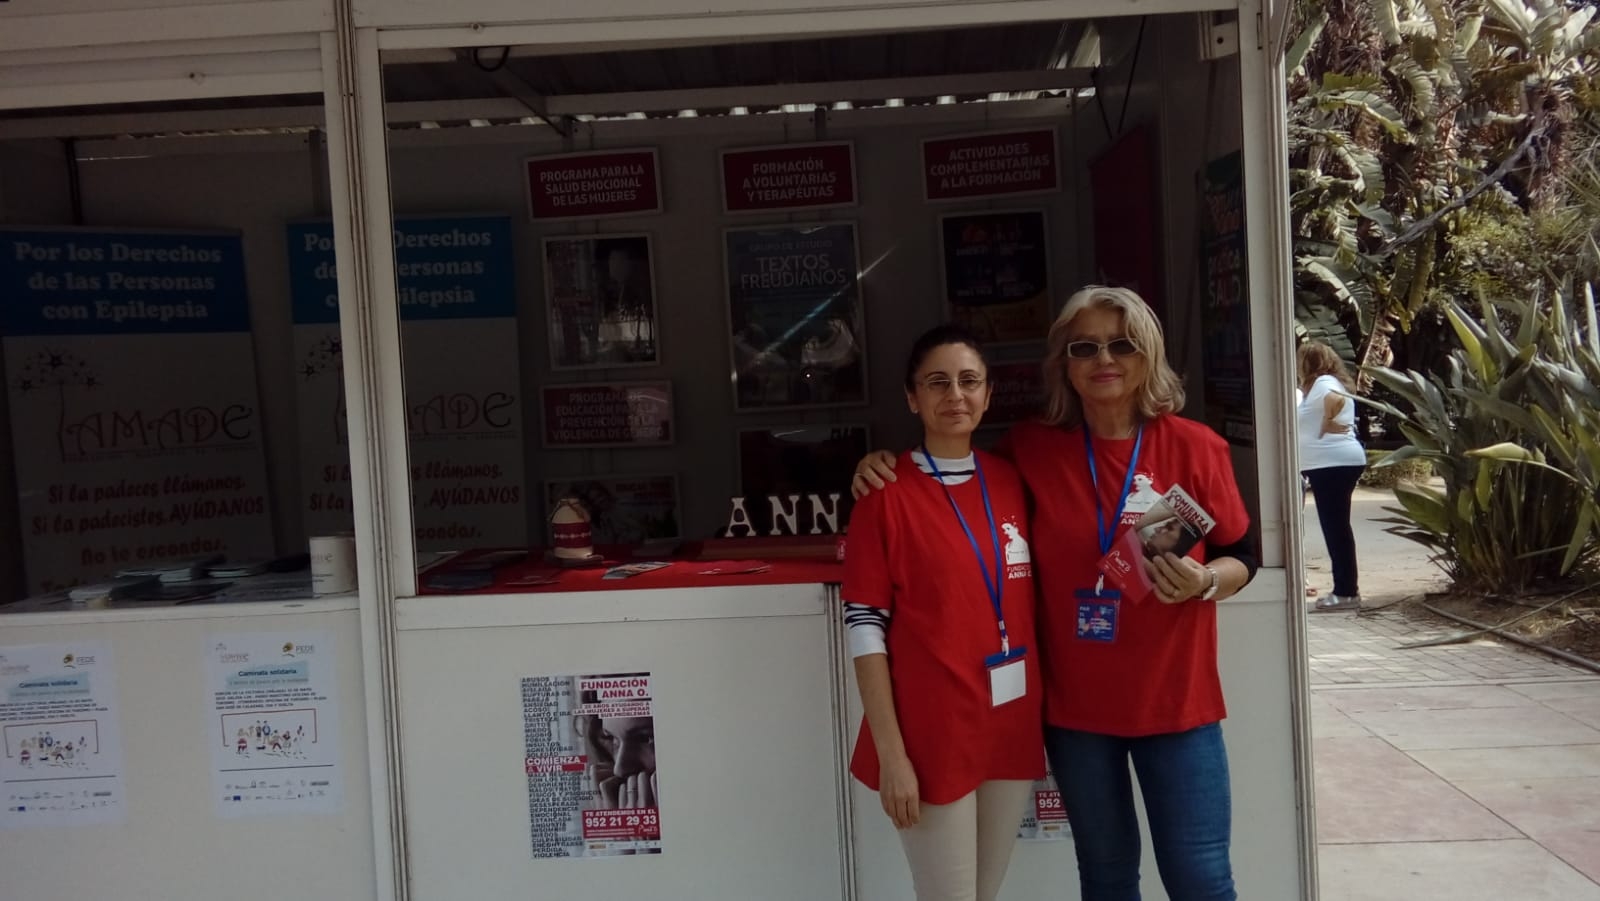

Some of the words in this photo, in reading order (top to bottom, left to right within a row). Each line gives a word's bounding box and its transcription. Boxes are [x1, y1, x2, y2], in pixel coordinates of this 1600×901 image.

[949, 142, 1030, 161] ACTIVIDADES
[540, 167, 600, 182] PROGRAMA
[601, 165, 630, 178] PARA
[630, 164, 645, 175] LA
[752, 156, 824, 175] FORMACIÓN
[930, 154, 1050, 176] COMPLEMENTARIAS
[545, 182, 580, 195] SALUD
[581, 177, 642, 192] EMOCIONAL
[743, 178, 752, 190] A
[752, 171, 837, 189] VOLUNTARIAS
[941, 180, 950, 190] A
[951, 176, 966, 188] LA
[552, 195, 566, 207] DE
[568, 193, 587, 206] LAS
[589, 189, 637, 203] MUJERES
[747, 191, 755, 202] Y
[14, 241, 61, 261] Por
[67, 243, 104, 262] los
[110, 243, 222, 263] Derechos
[399, 260, 484, 277] ersonas
[756, 253, 830, 272] TEXTOS
[28, 272, 58, 290] de
[65, 272, 101, 290] las
[107, 271, 215, 291] Personas
[741, 269, 846, 289] FREUDIANOS
[42, 304, 88, 319] con
[95, 300, 209, 323] Epilepsia
[49, 485, 63, 504] Si
[70, 484, 89, 502] la
[94, 480, 158, 504] padeces
[1170, 490, 1210, 532] COMIENZA
[32, 516, 48, 535] Si
[53, 515, 73, 534] la
[112, 545, 129, 562] te
[580, 677, 648, 689] FUNDACIÓN
[602, 689, 634, 699] ANNA
[637, 688, 649, 697] O.
[527, 756, 580, 765] COMIENZA
[537, 765, 562, 773] VIVIR
[1039, 799, 1061, 808] 952
[586, 817, 606, 827] 952
[610, 816, 622, 826] 21
[626, 816, 640, 826] 29
[643, 815, 657, 825] 33
